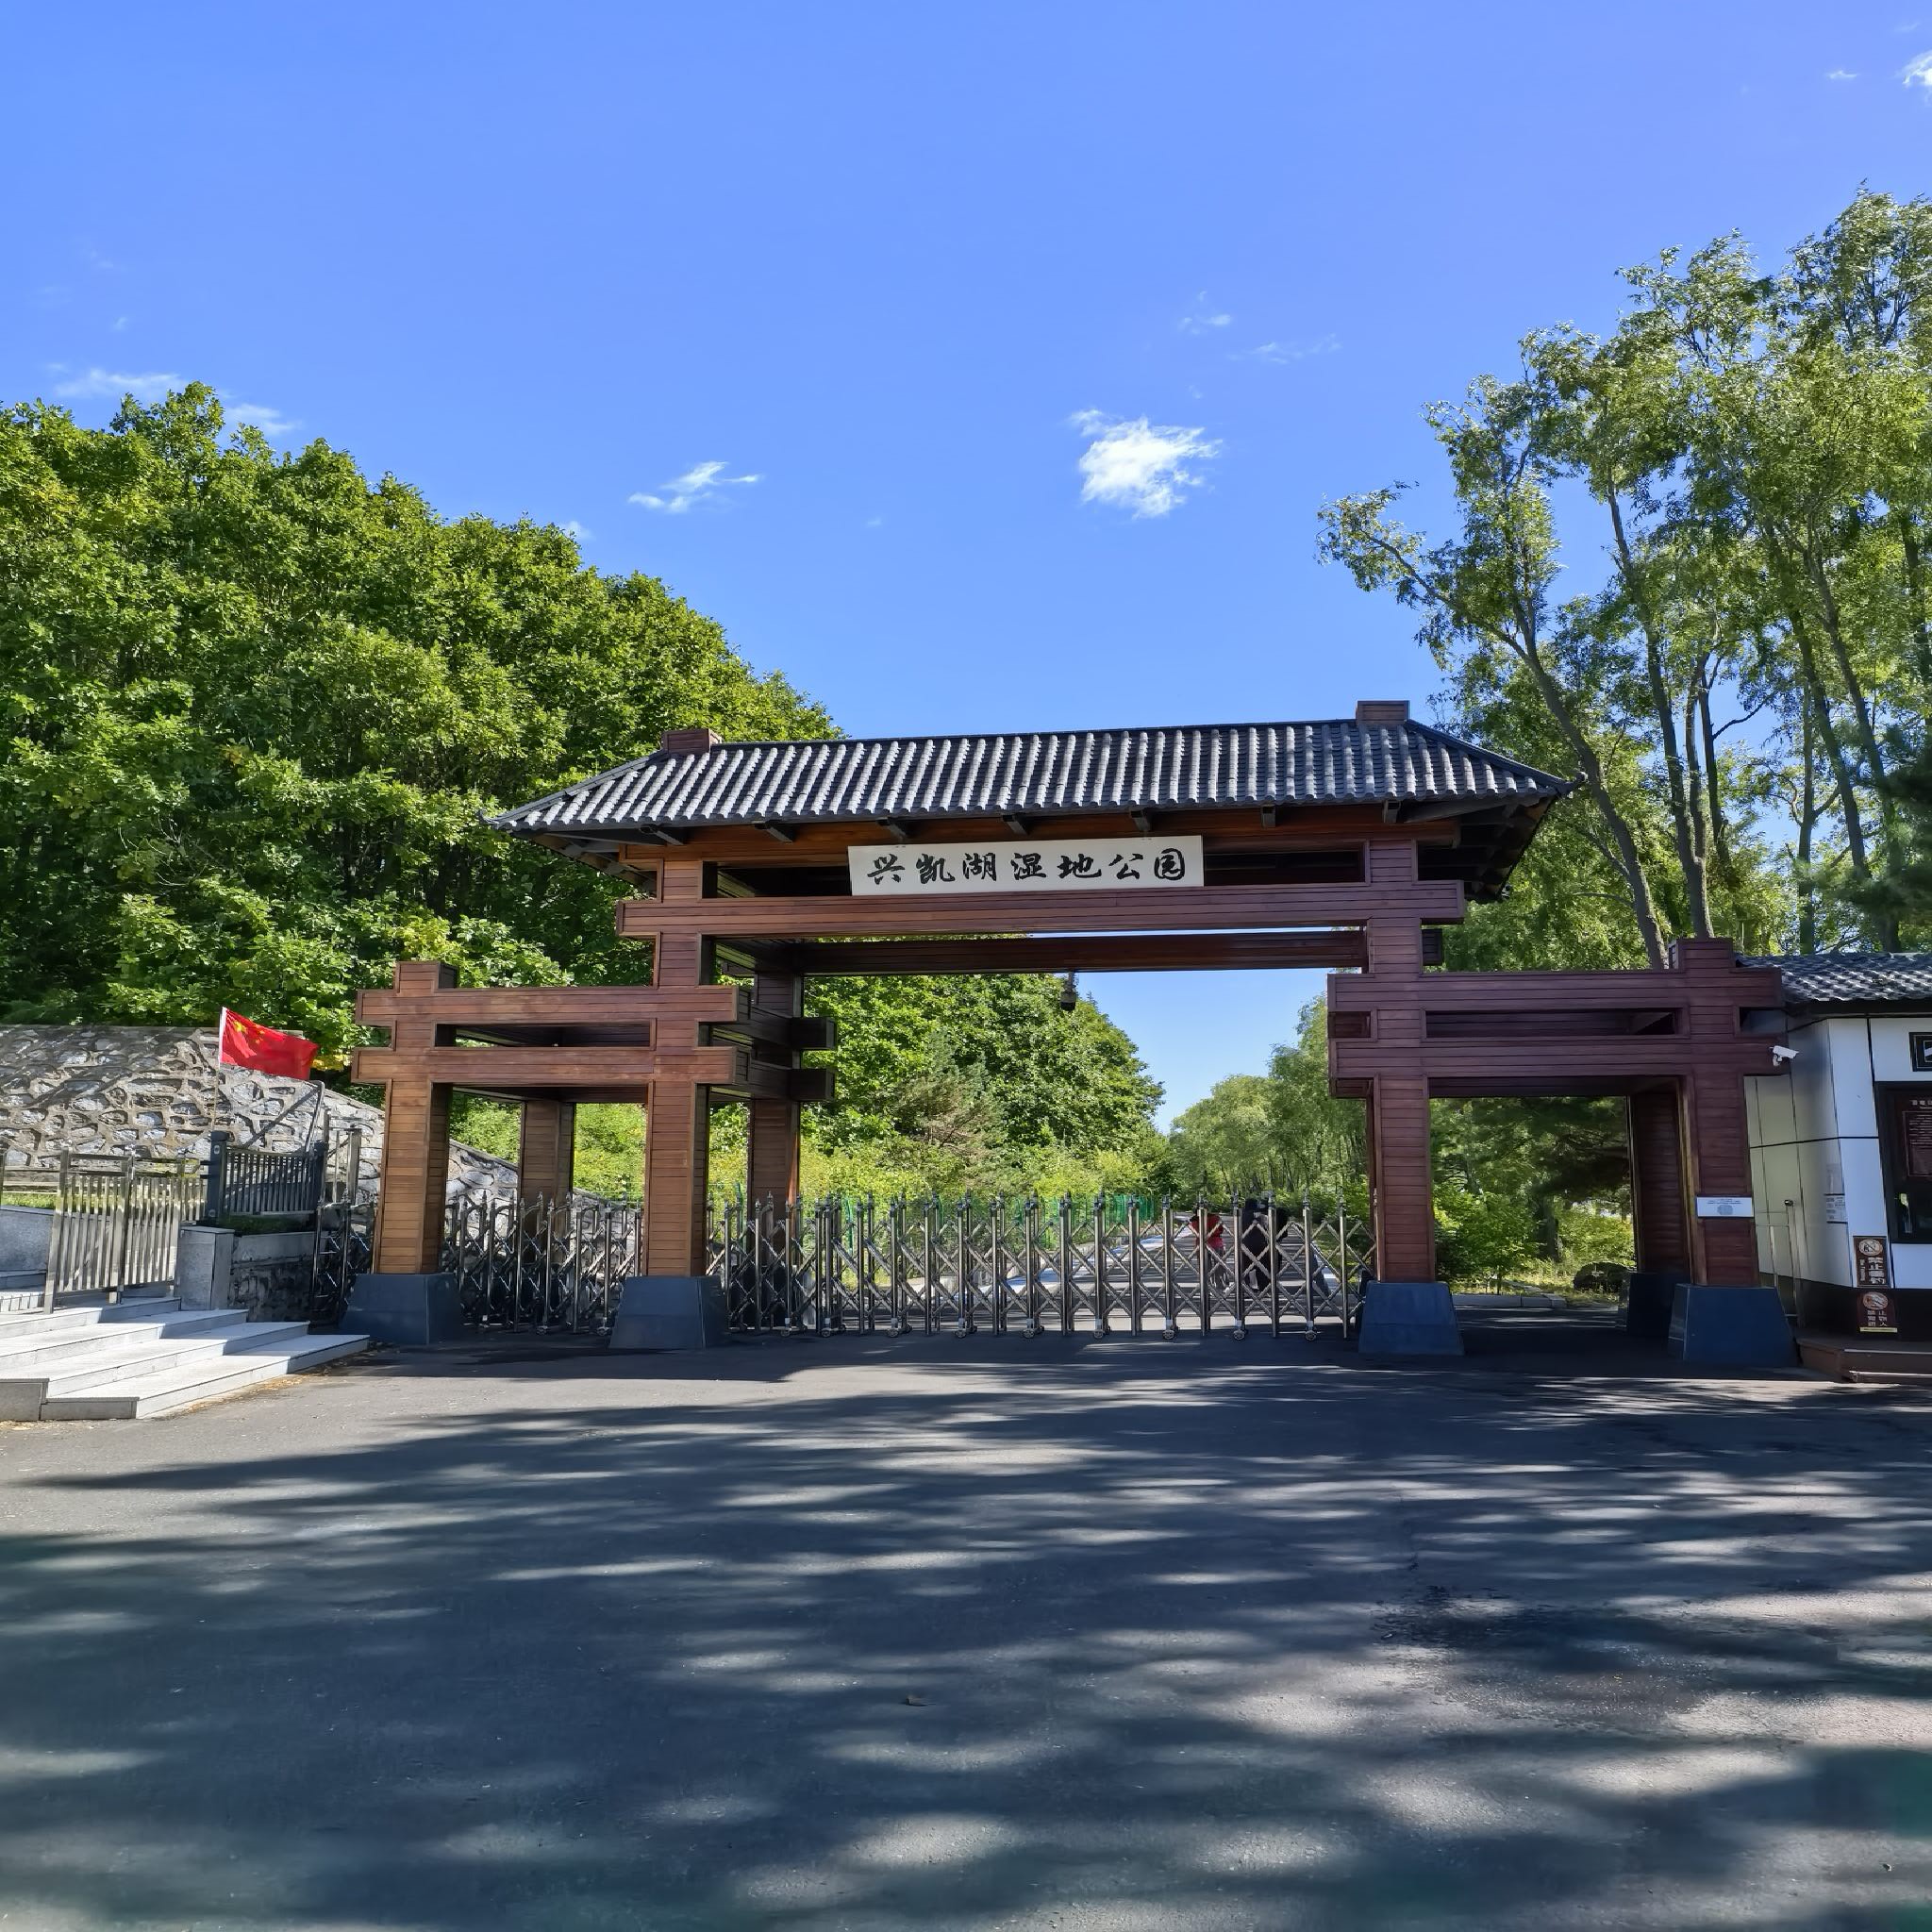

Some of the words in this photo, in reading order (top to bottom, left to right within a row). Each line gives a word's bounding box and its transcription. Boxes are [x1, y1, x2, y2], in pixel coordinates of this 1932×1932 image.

[867, 848, 1185, 885] 兴凯湖湿地公园
